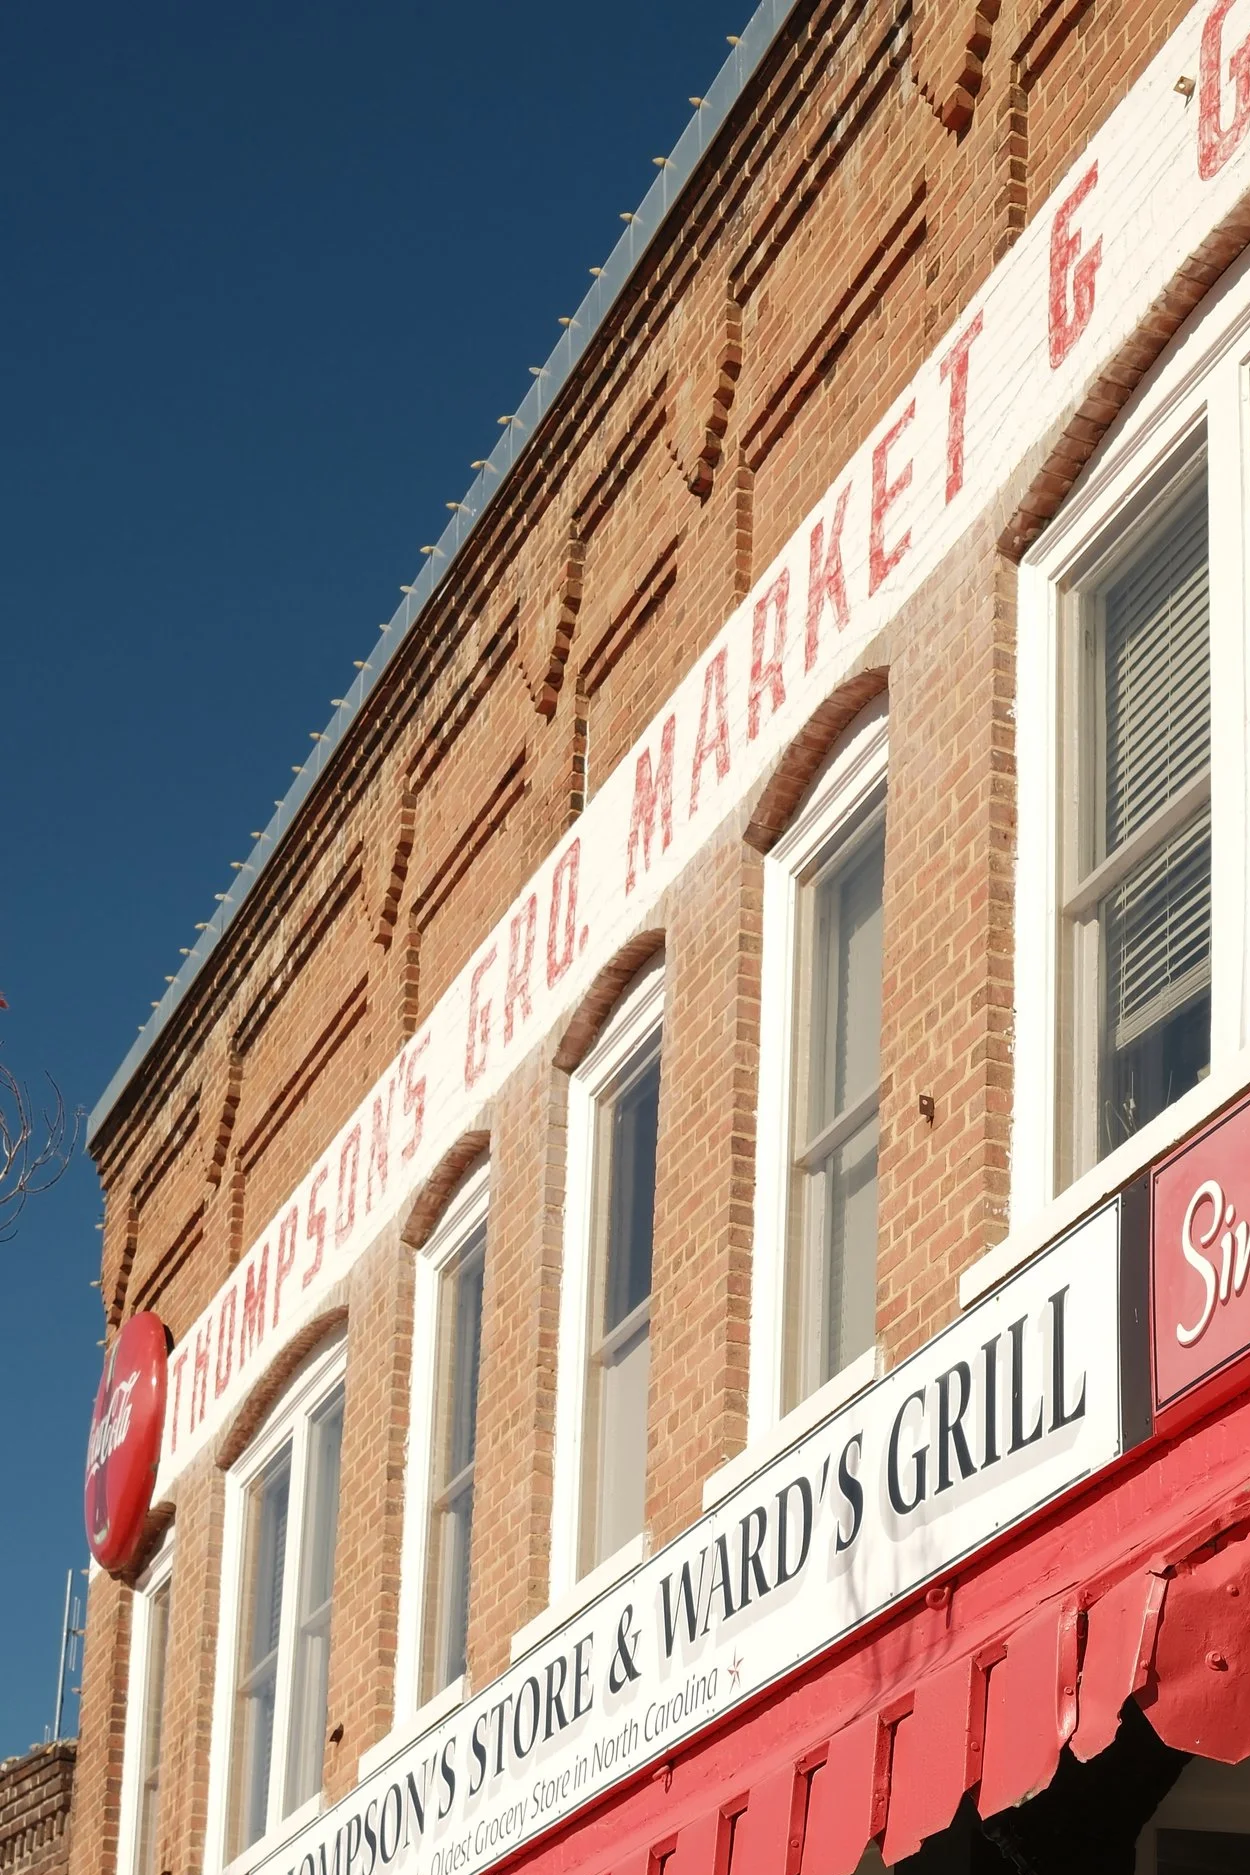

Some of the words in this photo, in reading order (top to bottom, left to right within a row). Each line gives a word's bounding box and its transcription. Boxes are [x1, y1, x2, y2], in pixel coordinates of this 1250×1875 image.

[171, 1031, 433, 1454] THOMPSON'S
[625, 308, 984, 898] MARKET
[468, 1632, 595, 1799] STORE
[608, 1603, 642, 1694] &
[659, 1429, 864, 1659] WARD'S
[887, 1284, 1088, 1516] GRILL
[474, 1796, 528, 1870] Grocery
[530, 1766, 570, 1818] Store
[573, 1754, 590, 1793] in
[593, 1715, 639, 1773] North
[643, 1663, 718, 1741] Carolina
